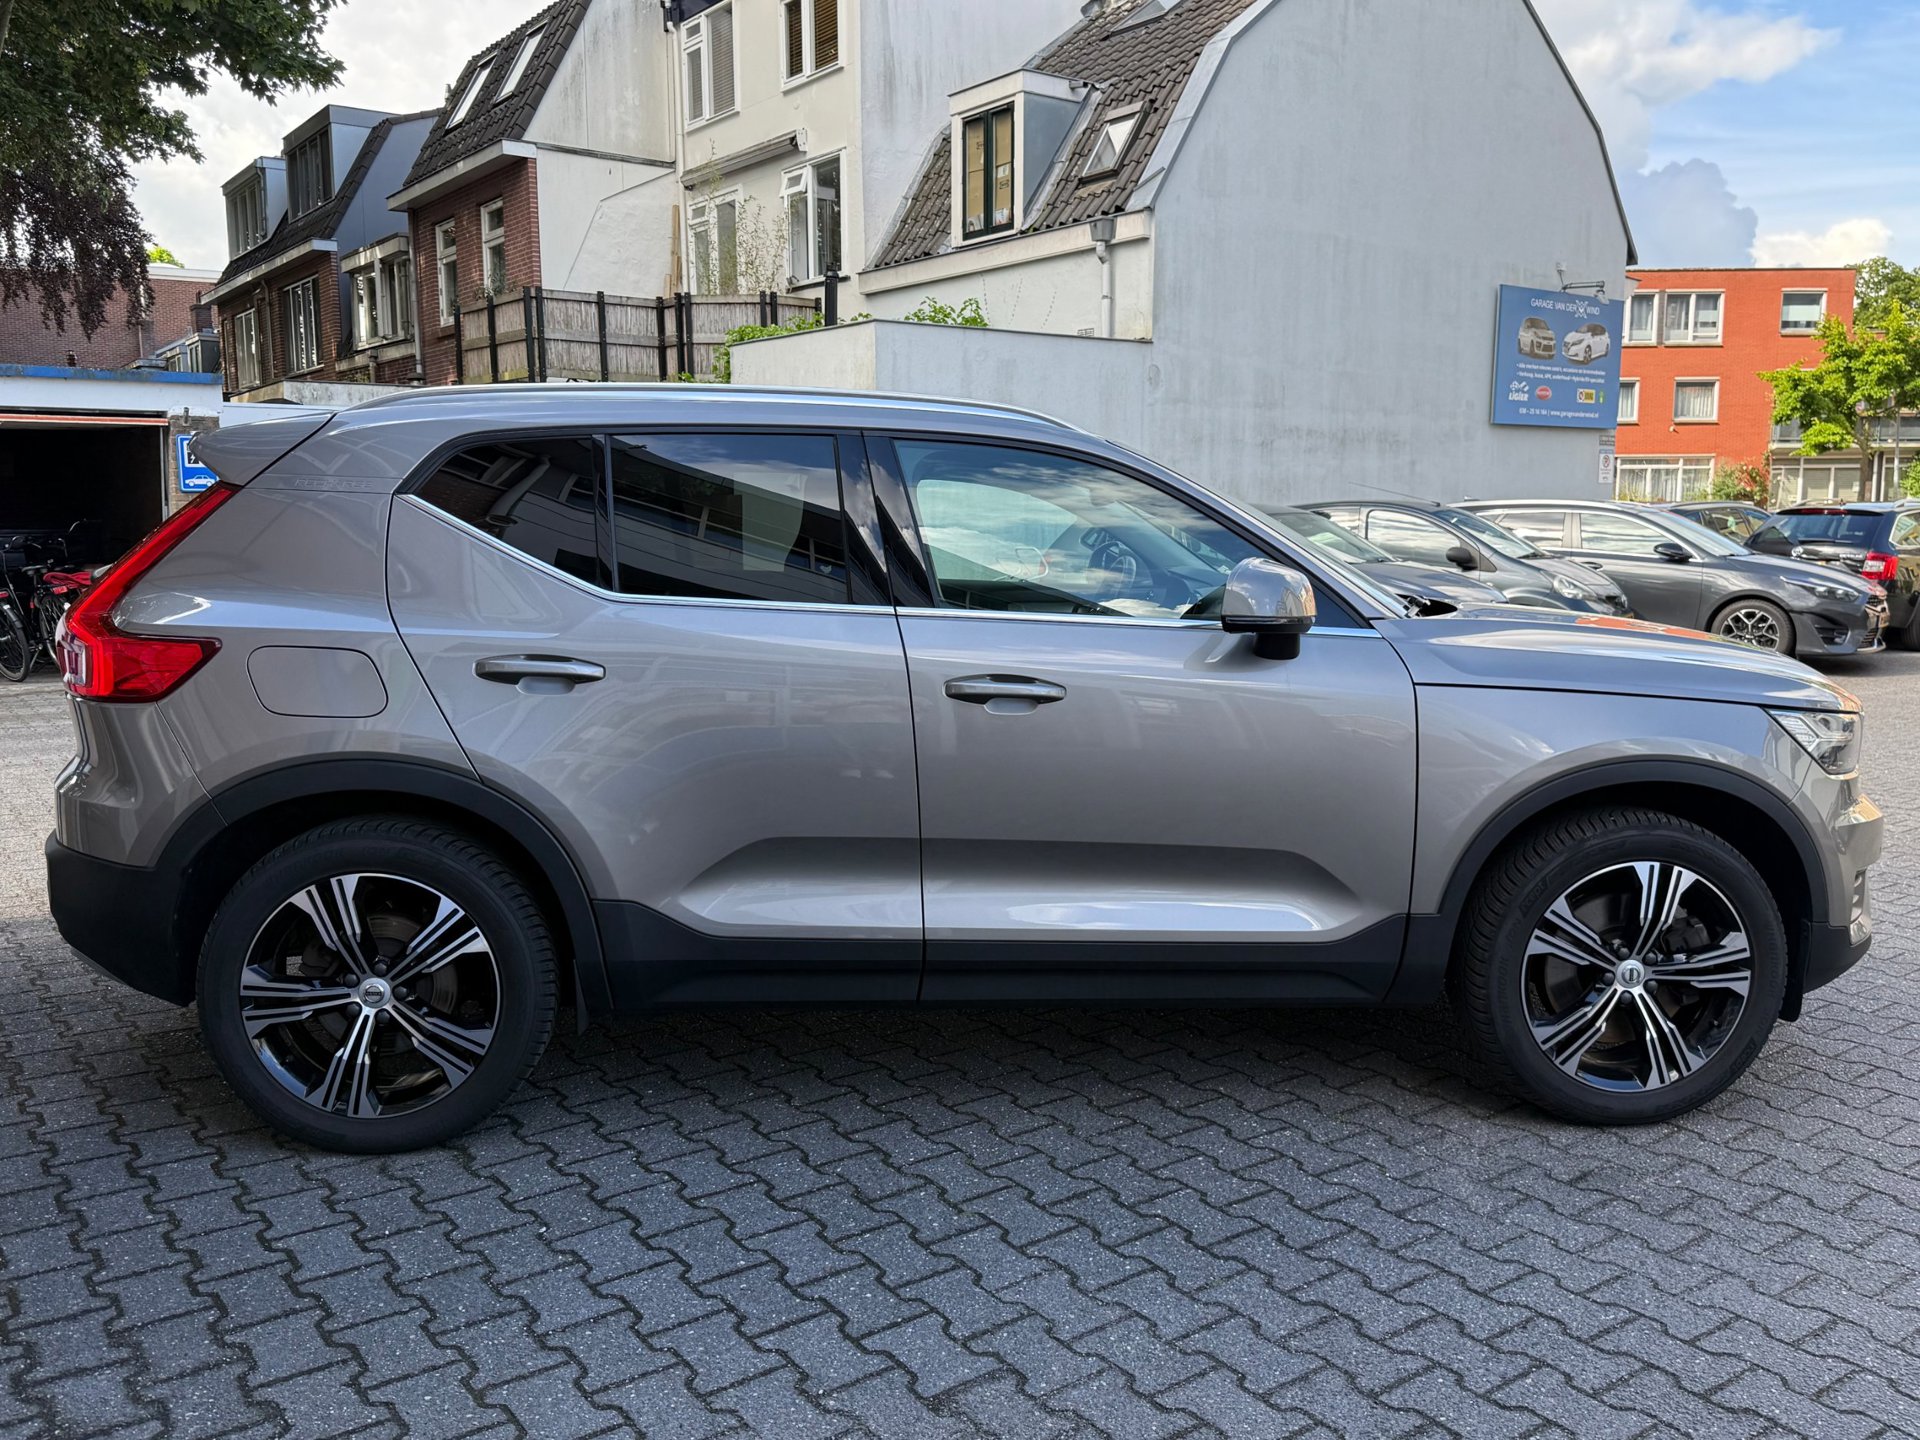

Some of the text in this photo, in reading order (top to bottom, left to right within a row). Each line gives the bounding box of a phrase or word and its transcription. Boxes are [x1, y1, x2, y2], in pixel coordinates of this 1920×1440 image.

[1530, 298, 1600, 315] GARAGE VAN DER WIND
